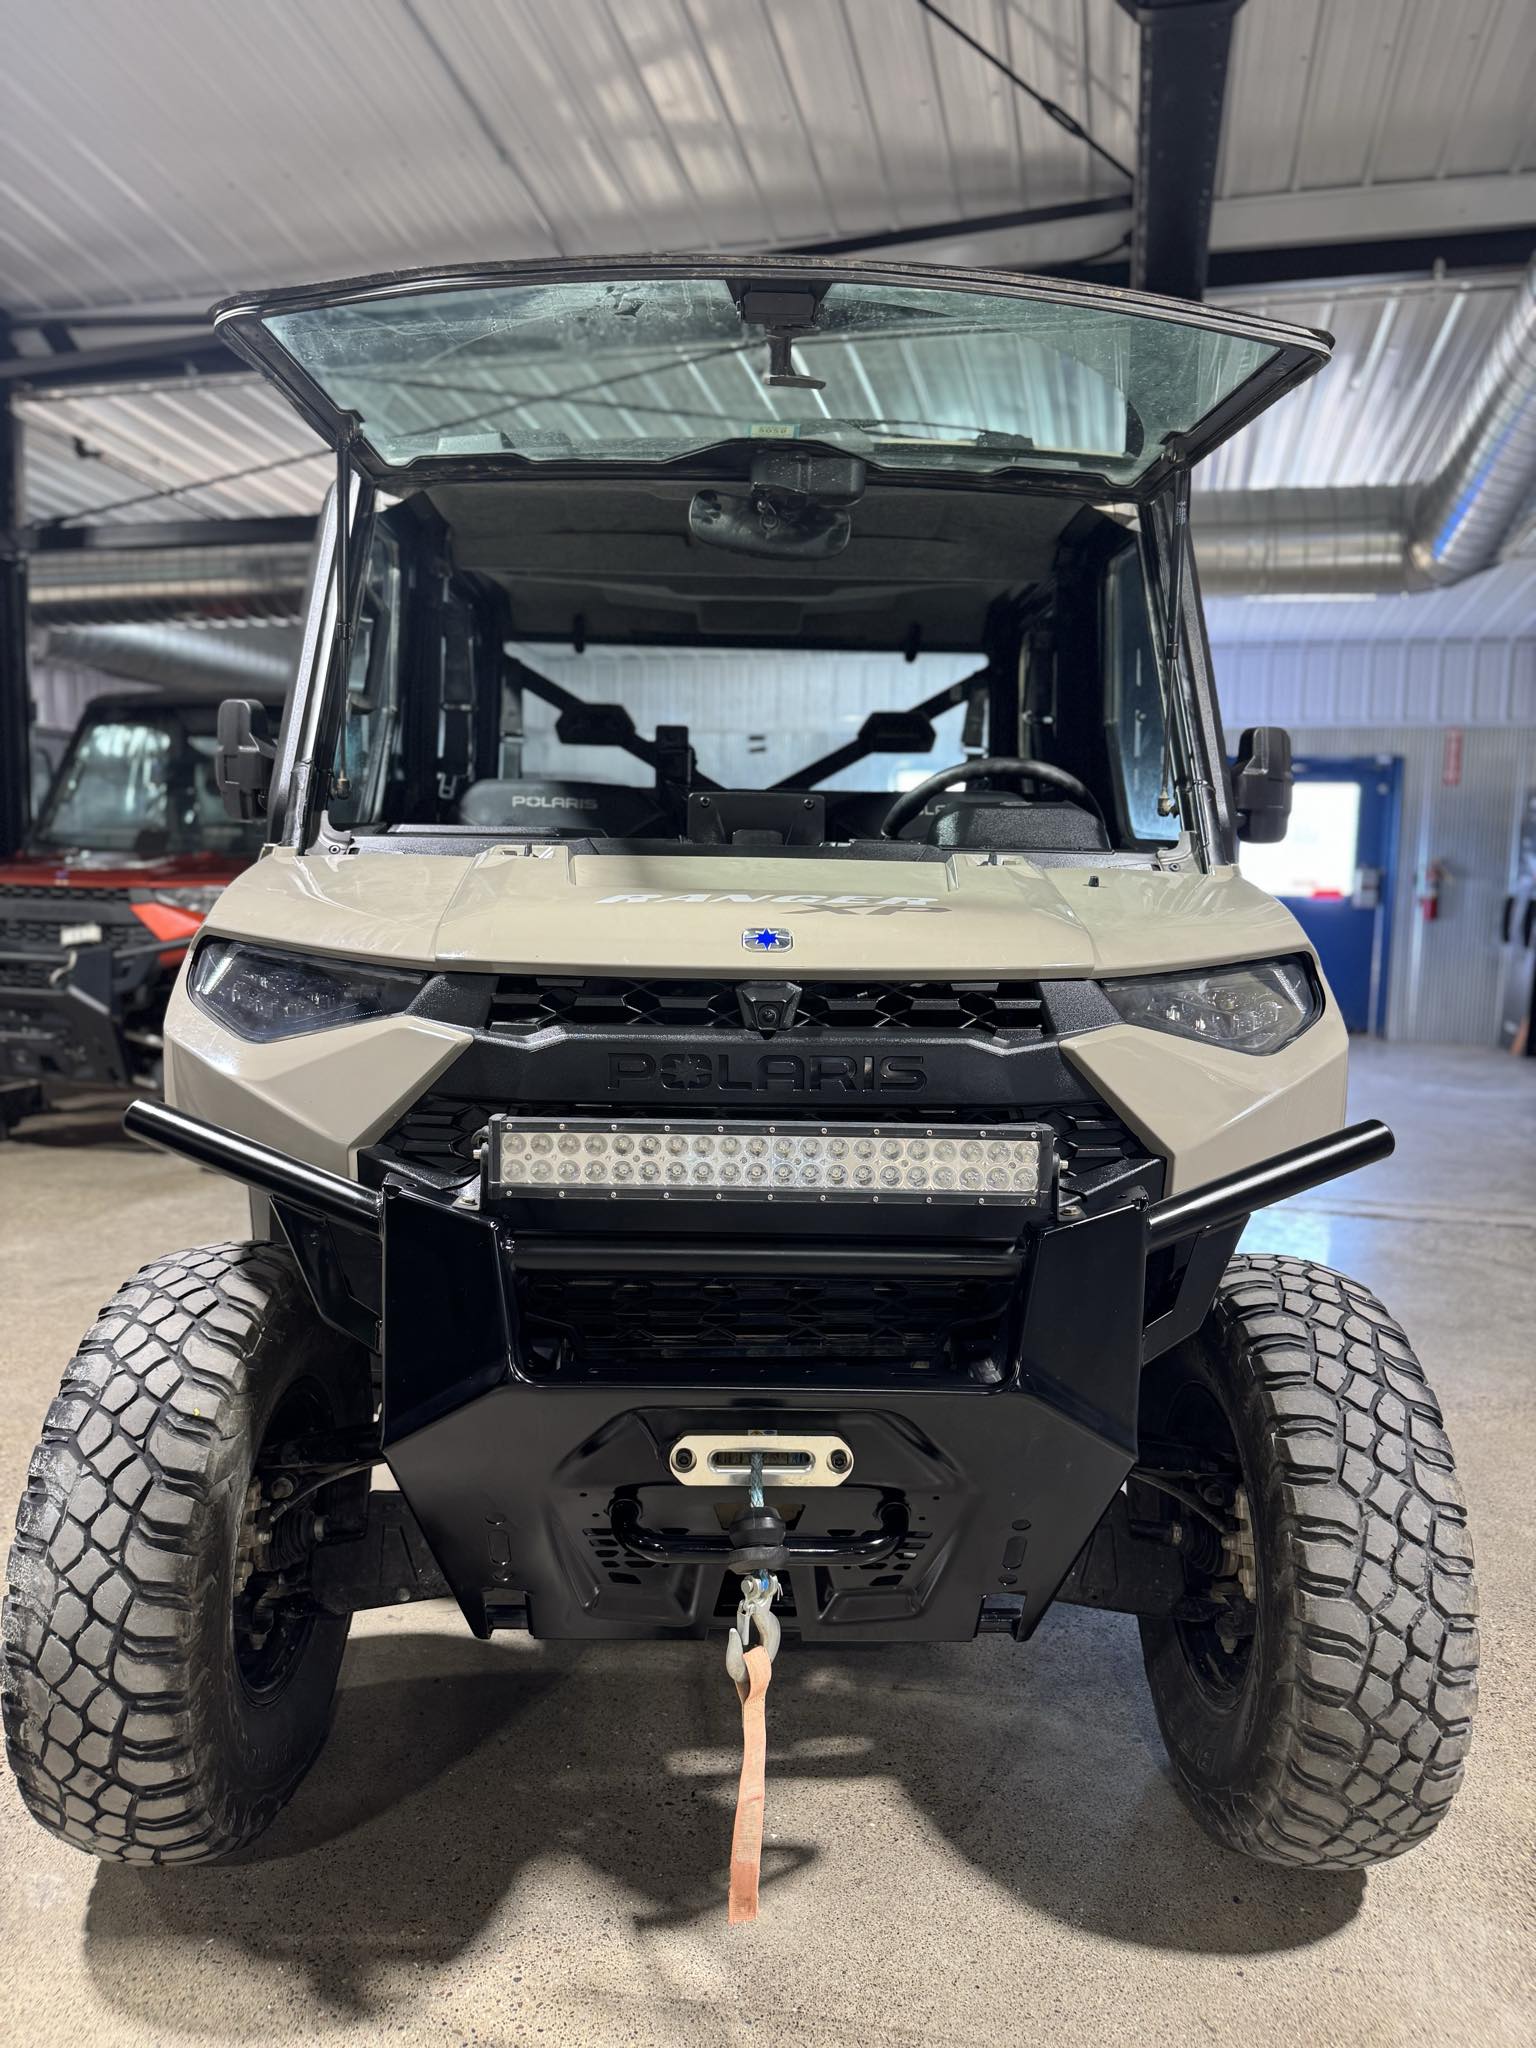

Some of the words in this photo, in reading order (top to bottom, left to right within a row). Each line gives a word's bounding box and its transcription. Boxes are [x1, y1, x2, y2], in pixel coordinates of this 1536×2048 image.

[512, 795, 598, 810] POLARIS
[597, 894, 939, 905] RANGER
[779, 903, 952, 916] XP
[607, 1053, 928, 1092] POLARIS
